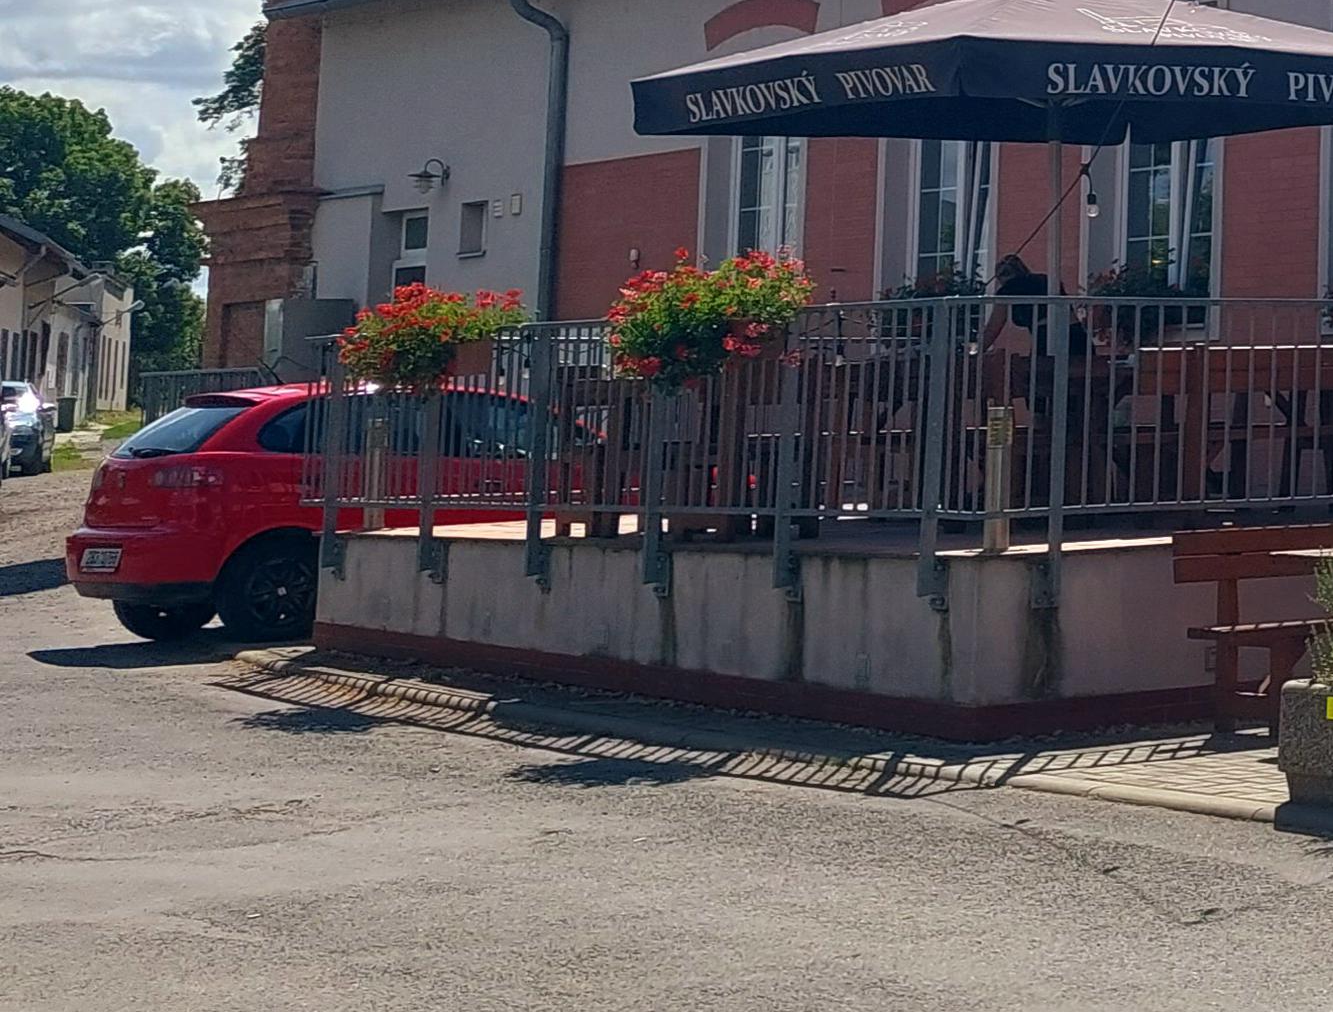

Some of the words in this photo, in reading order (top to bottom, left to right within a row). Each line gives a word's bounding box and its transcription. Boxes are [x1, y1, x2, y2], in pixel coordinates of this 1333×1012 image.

[686, 70, 822, 123] SLAVKOVSKÝ
[836, 64, 936, 100] PIVOVAR
[1046, 62, 1256, 98] SLAVKOVSKÝ
